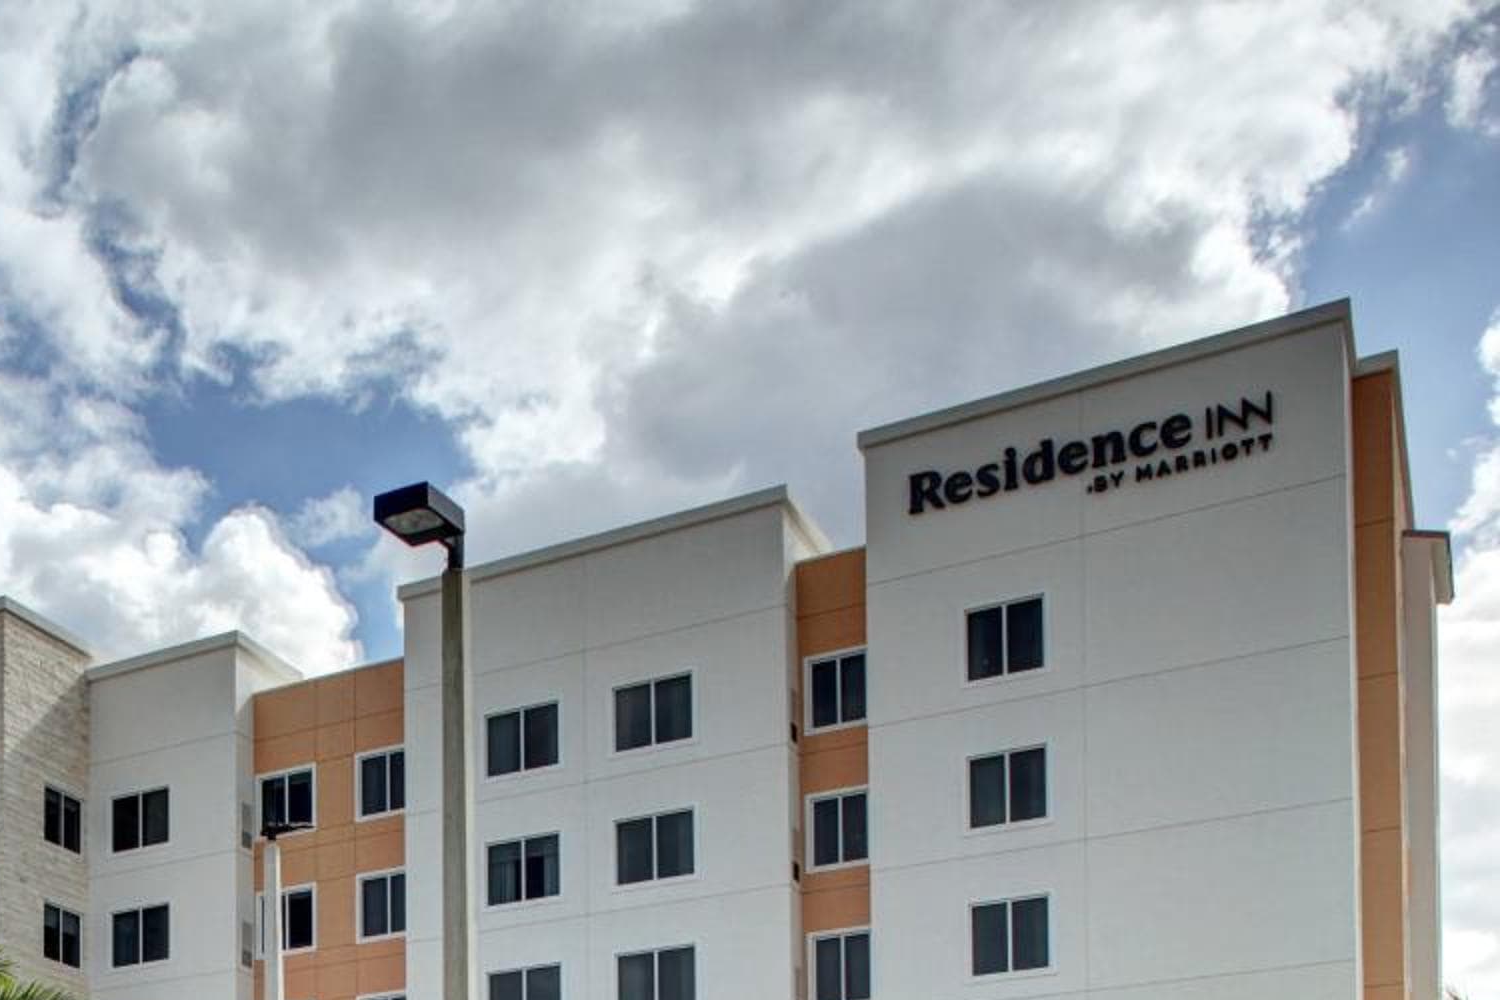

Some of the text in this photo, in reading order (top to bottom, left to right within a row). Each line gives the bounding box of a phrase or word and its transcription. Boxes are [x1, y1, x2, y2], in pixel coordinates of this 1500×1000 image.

[908, 389, 1275, 515] Residence INN
[1134, 432, 1274, 484] MARRIOTT
